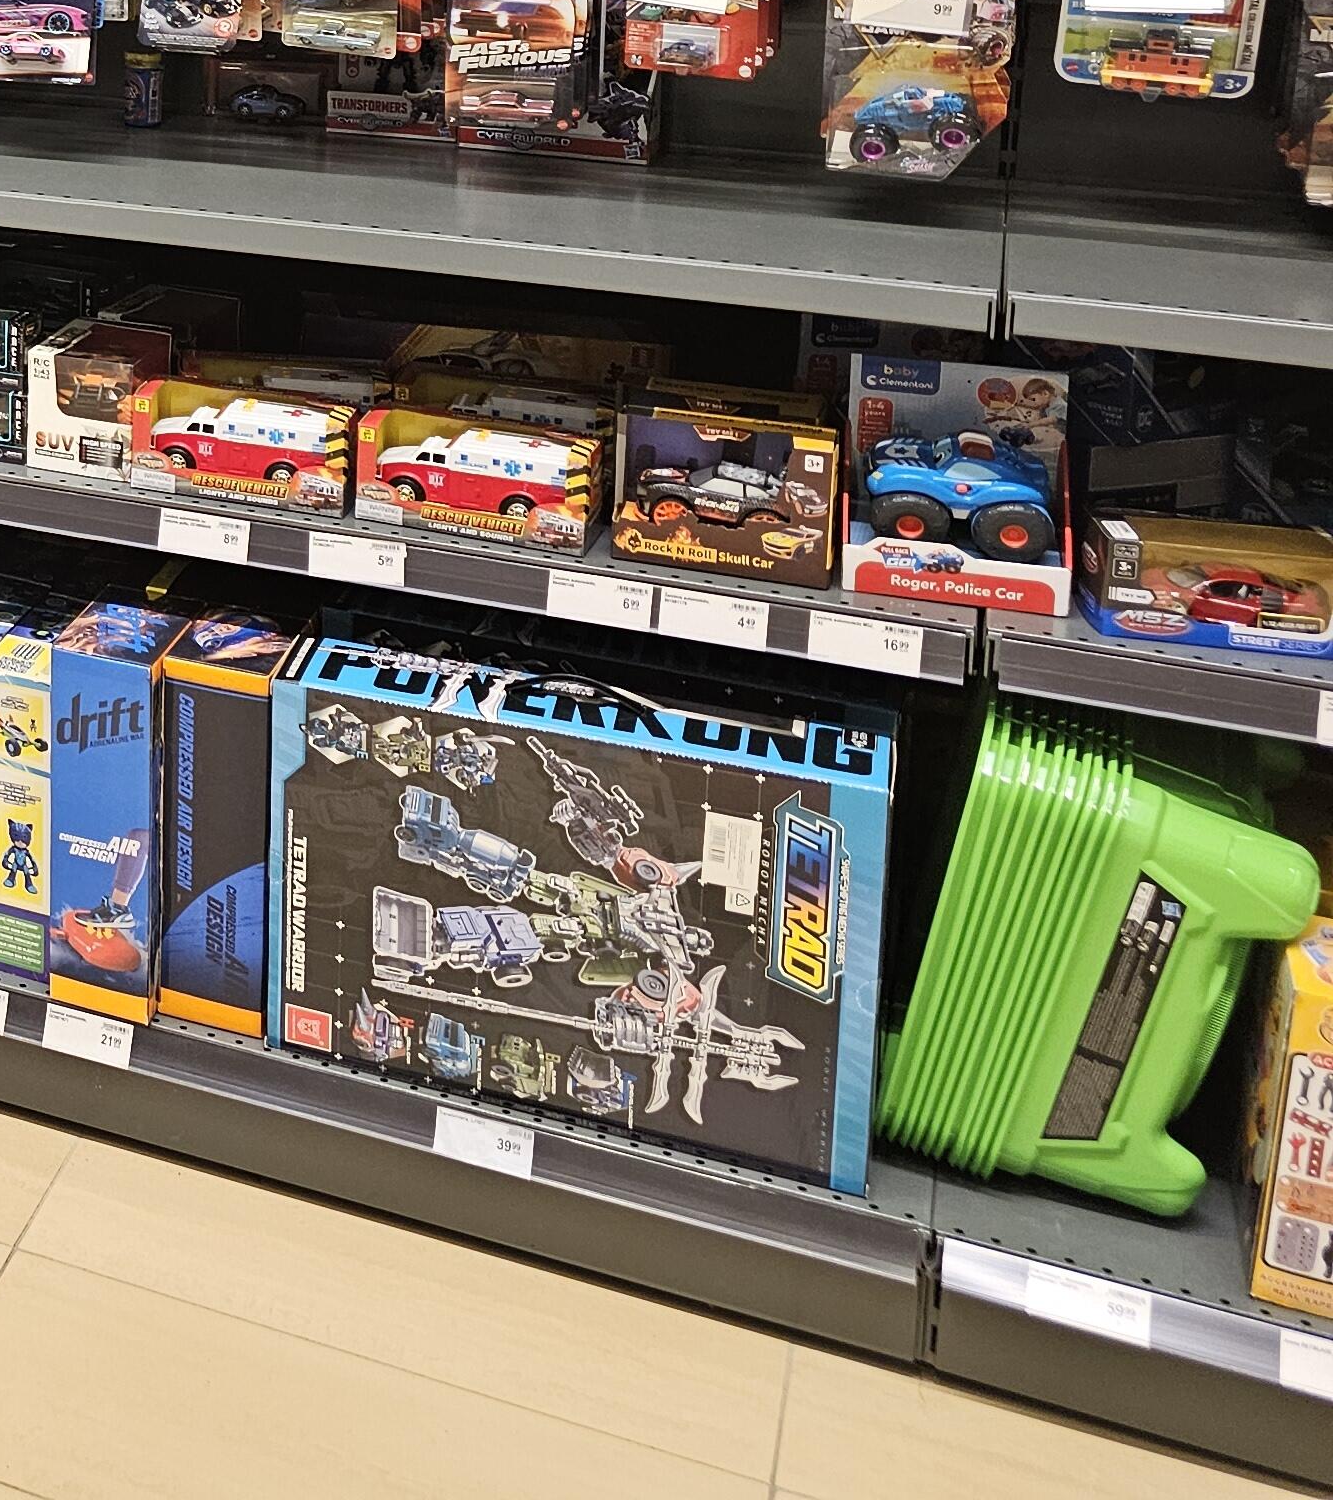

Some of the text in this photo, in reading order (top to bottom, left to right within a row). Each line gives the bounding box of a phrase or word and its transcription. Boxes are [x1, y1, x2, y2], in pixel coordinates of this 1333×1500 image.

[450, 40, 518, 63] FAST
[457, 48, 572, 73] FURIOUS
[1224, 80, 1242, 91] 3+
[332, 97, 408, 115] TRANSFORMERS
[883, 364, 919, 380] baby
[35, 430, 74, 451] SUV
[807, 457, 821, 471] 3+
[192, 473, 288, 499] RESCUE VEHICLE
[421, 506, 524, 536] RESCUE VEHICLE
[643, 539, 775, 571] Rock N Roll Skull Car
[890, 572, 1024, 601] Roger, Police Car
[1233, 633, 1278, 649] STREET
[56, 691, 146, 754] drift
[176, 692, 195, 891] COMPRESSED AIR DESIGN
[69, 841, 117, 865] DESIGN
[108, 836, 141, 856] AIR
[756, 837, 771, 946] ROBOT MECHA
[783, 815, 832, 990] TETRAD
[288, 835, 308, 993] TETRAD WARRIOR
